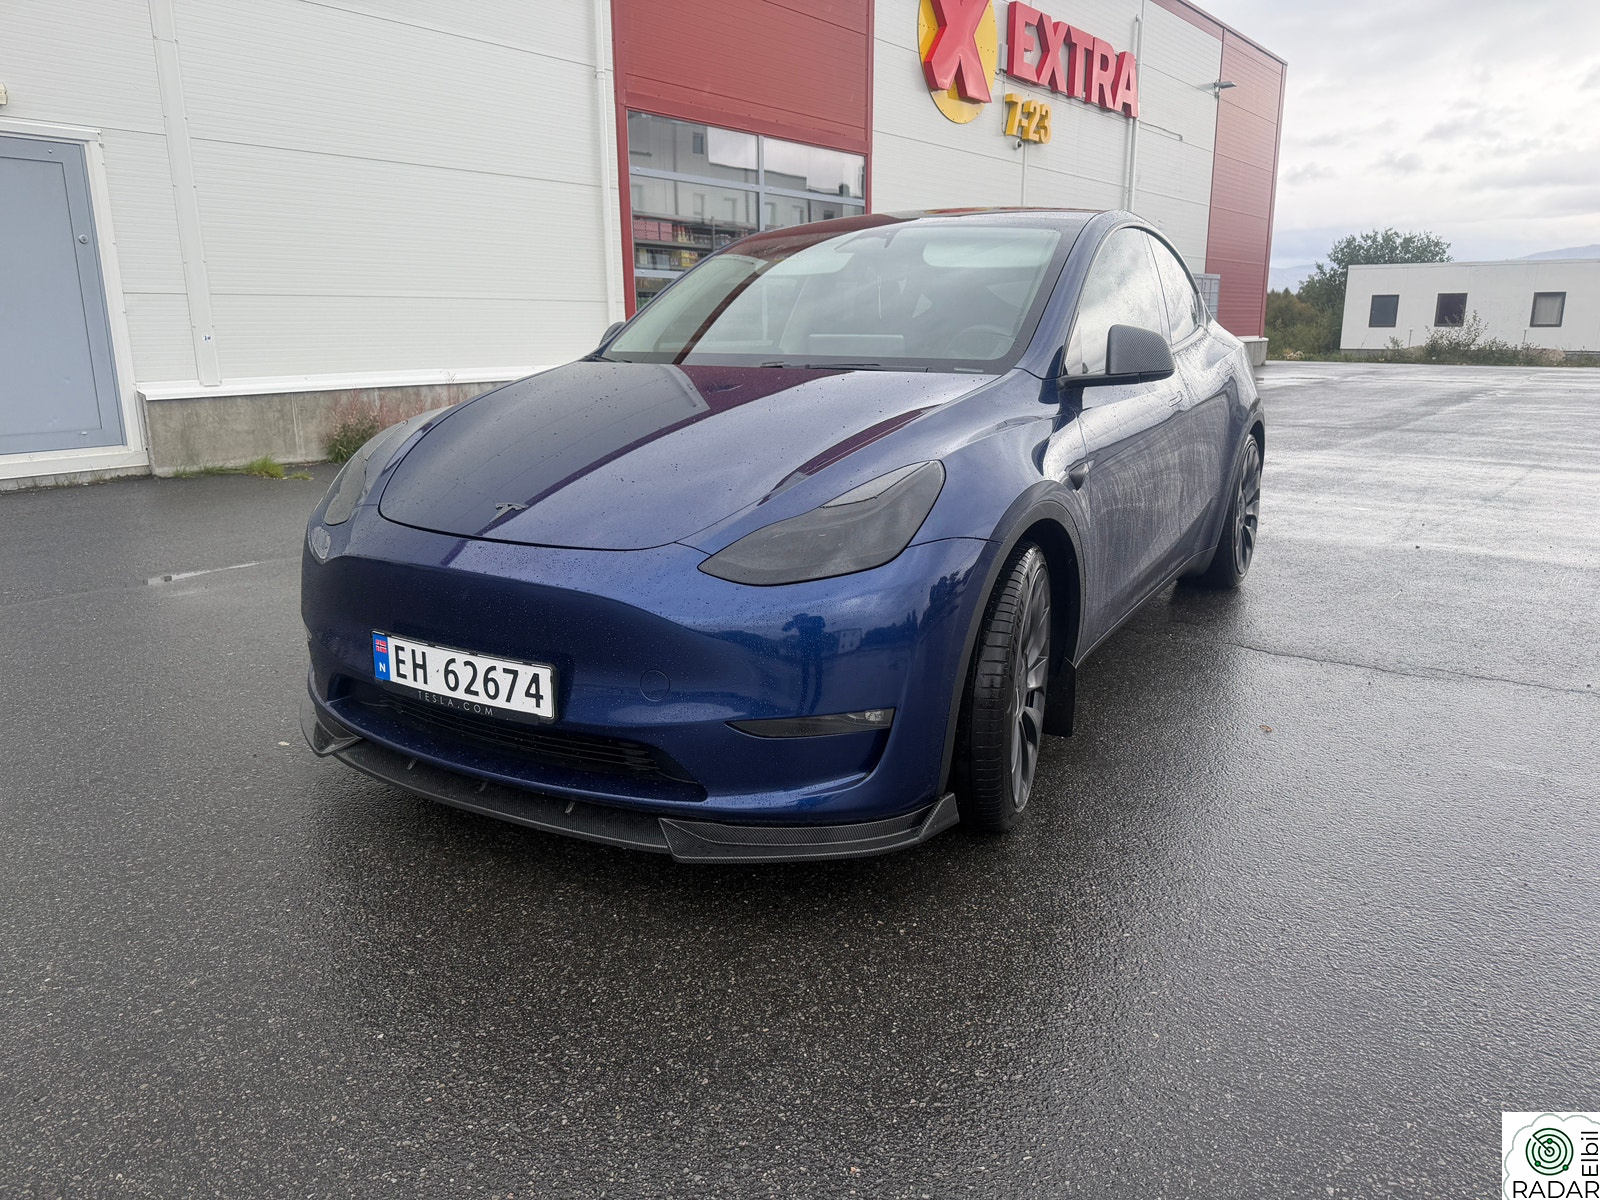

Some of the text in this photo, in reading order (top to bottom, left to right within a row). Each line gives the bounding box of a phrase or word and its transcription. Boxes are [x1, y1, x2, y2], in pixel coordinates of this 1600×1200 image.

[1007, 1, 1138, 118] EXTRA
[1005, 93, 1052, 144] 7-23
[378, 662, 386, 673] N
[394, 645, 544, 708] EH 62674
[418, 691, 493, 716] TESLA.COM
